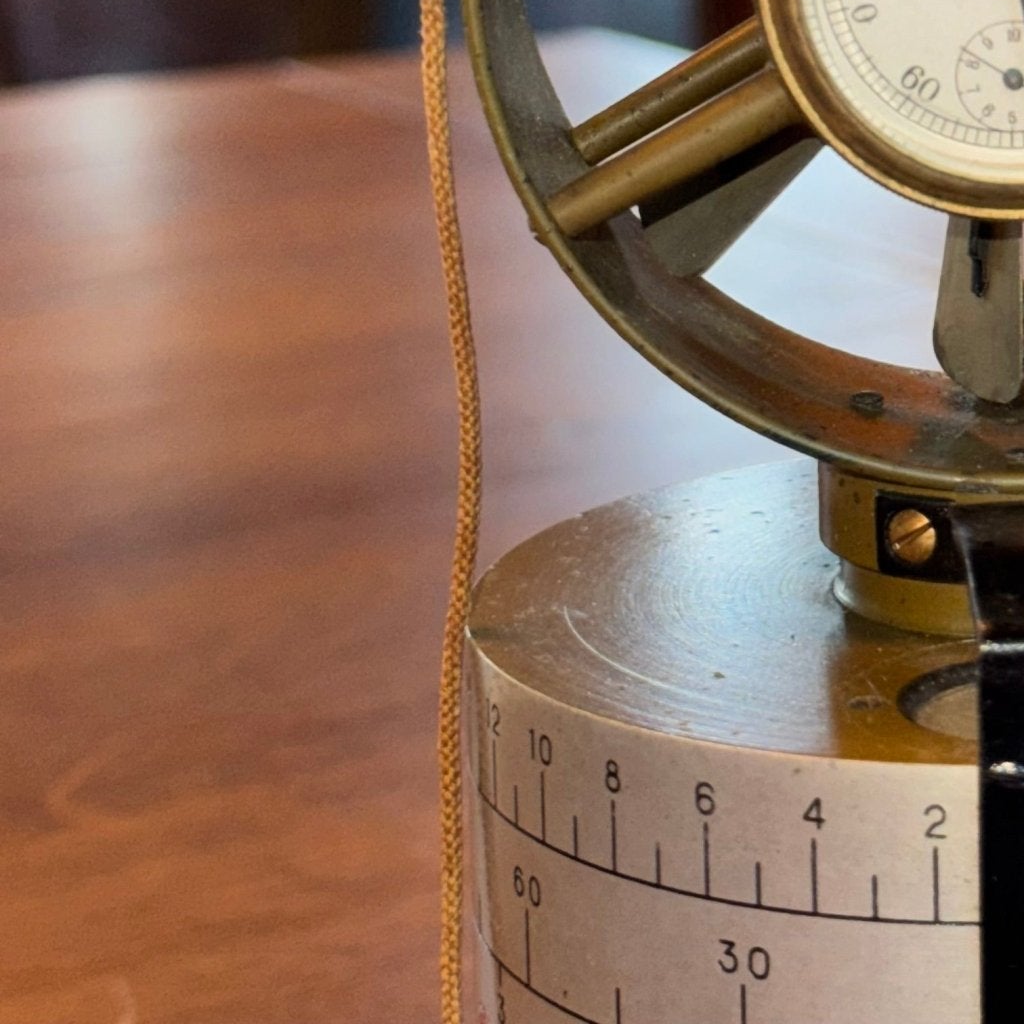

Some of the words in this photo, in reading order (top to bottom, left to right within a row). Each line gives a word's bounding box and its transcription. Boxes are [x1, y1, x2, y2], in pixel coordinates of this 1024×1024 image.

[1007, 28, 1021, 42] 10
[901, 65, 941, 103] 60
[1007, 110, 1018, 125] 5
[529, 728, 552, 766] 10
[605, 759, 621, 793] 8
[695, 781, 716, 816] 6
[803, 797, 826, 829] 4
[924, 804, 947, 839] 2
[514, 865, 541, 907] 60
[718, 938, 769, 980] 30
